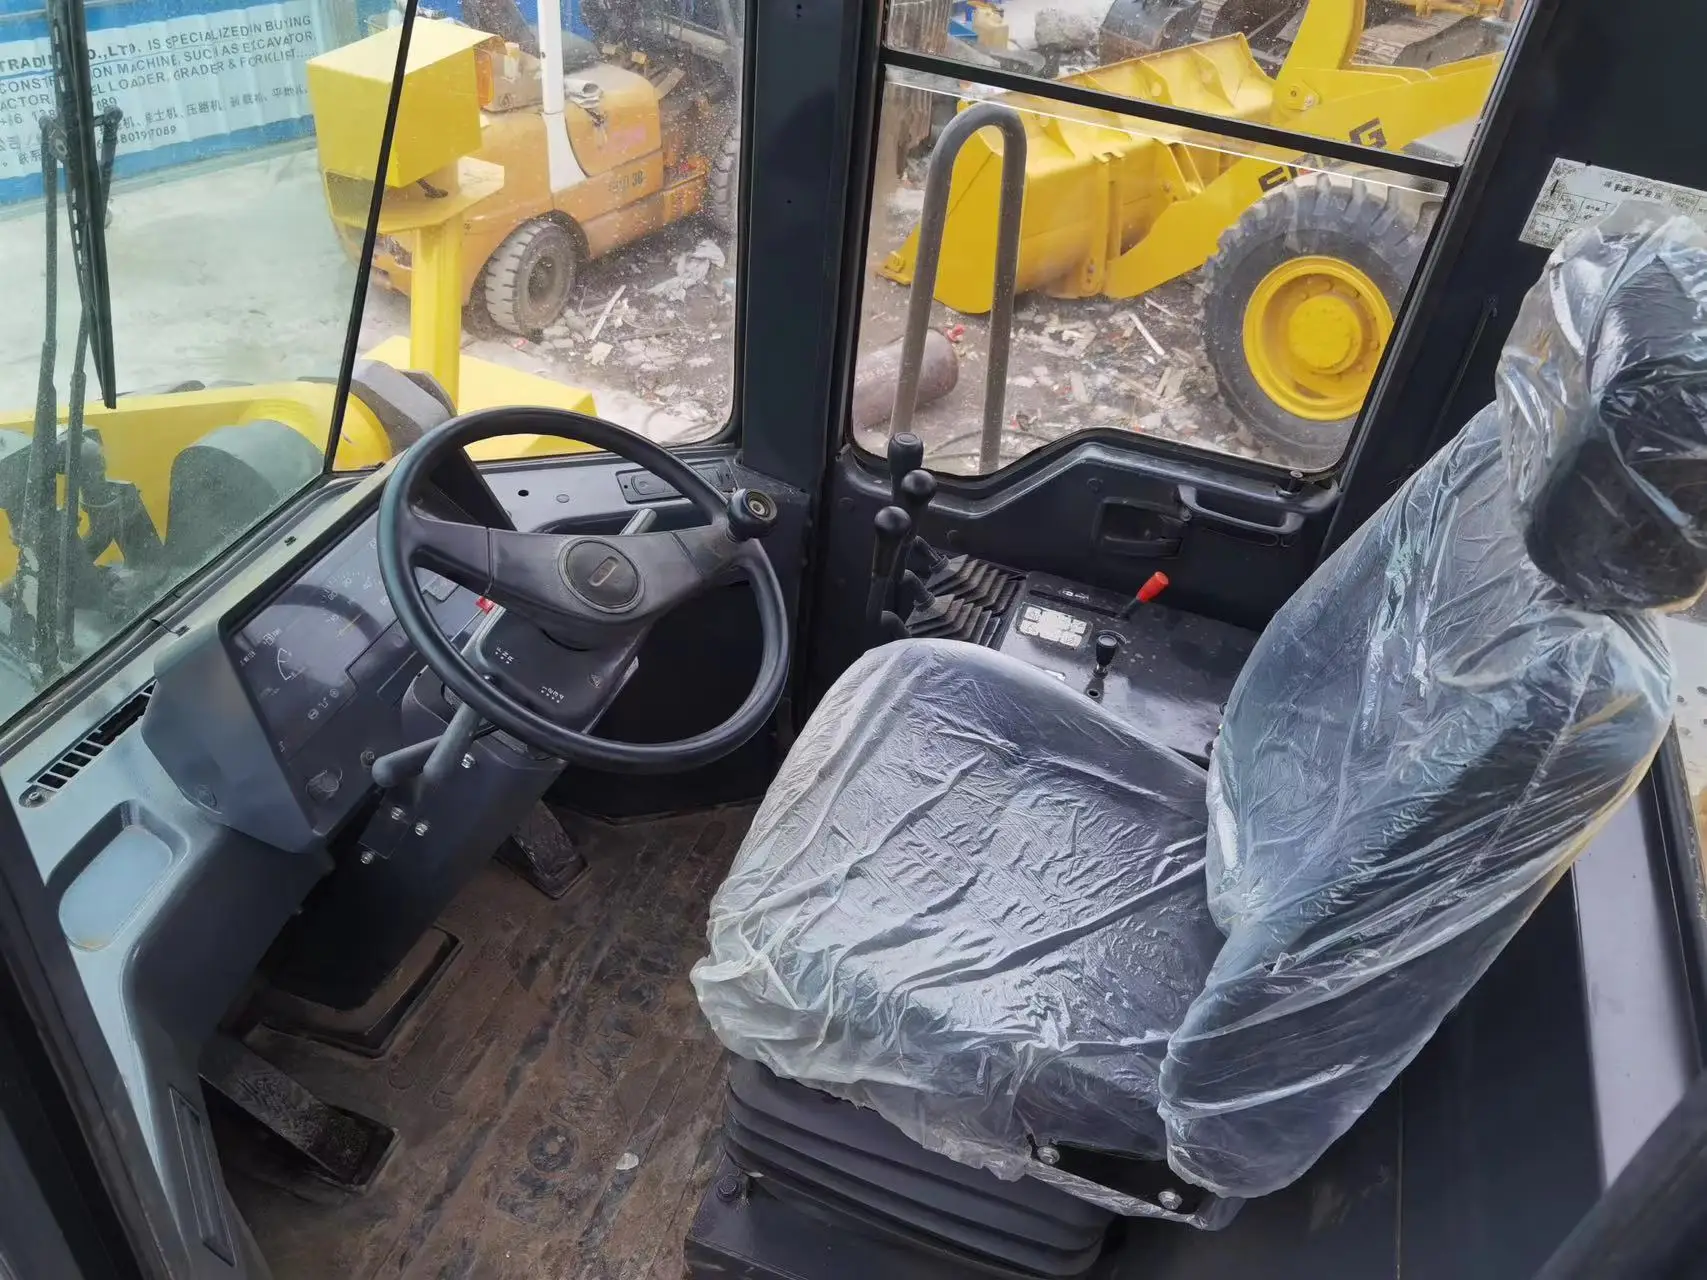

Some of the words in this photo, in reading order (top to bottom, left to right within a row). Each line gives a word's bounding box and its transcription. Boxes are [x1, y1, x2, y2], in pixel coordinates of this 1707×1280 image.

[148, 39, 161, 51] IS
[266, 15, 311, 31] BUYING
[174, 61, 224, 81] GRADER
[228, 58, 237, 69] &
